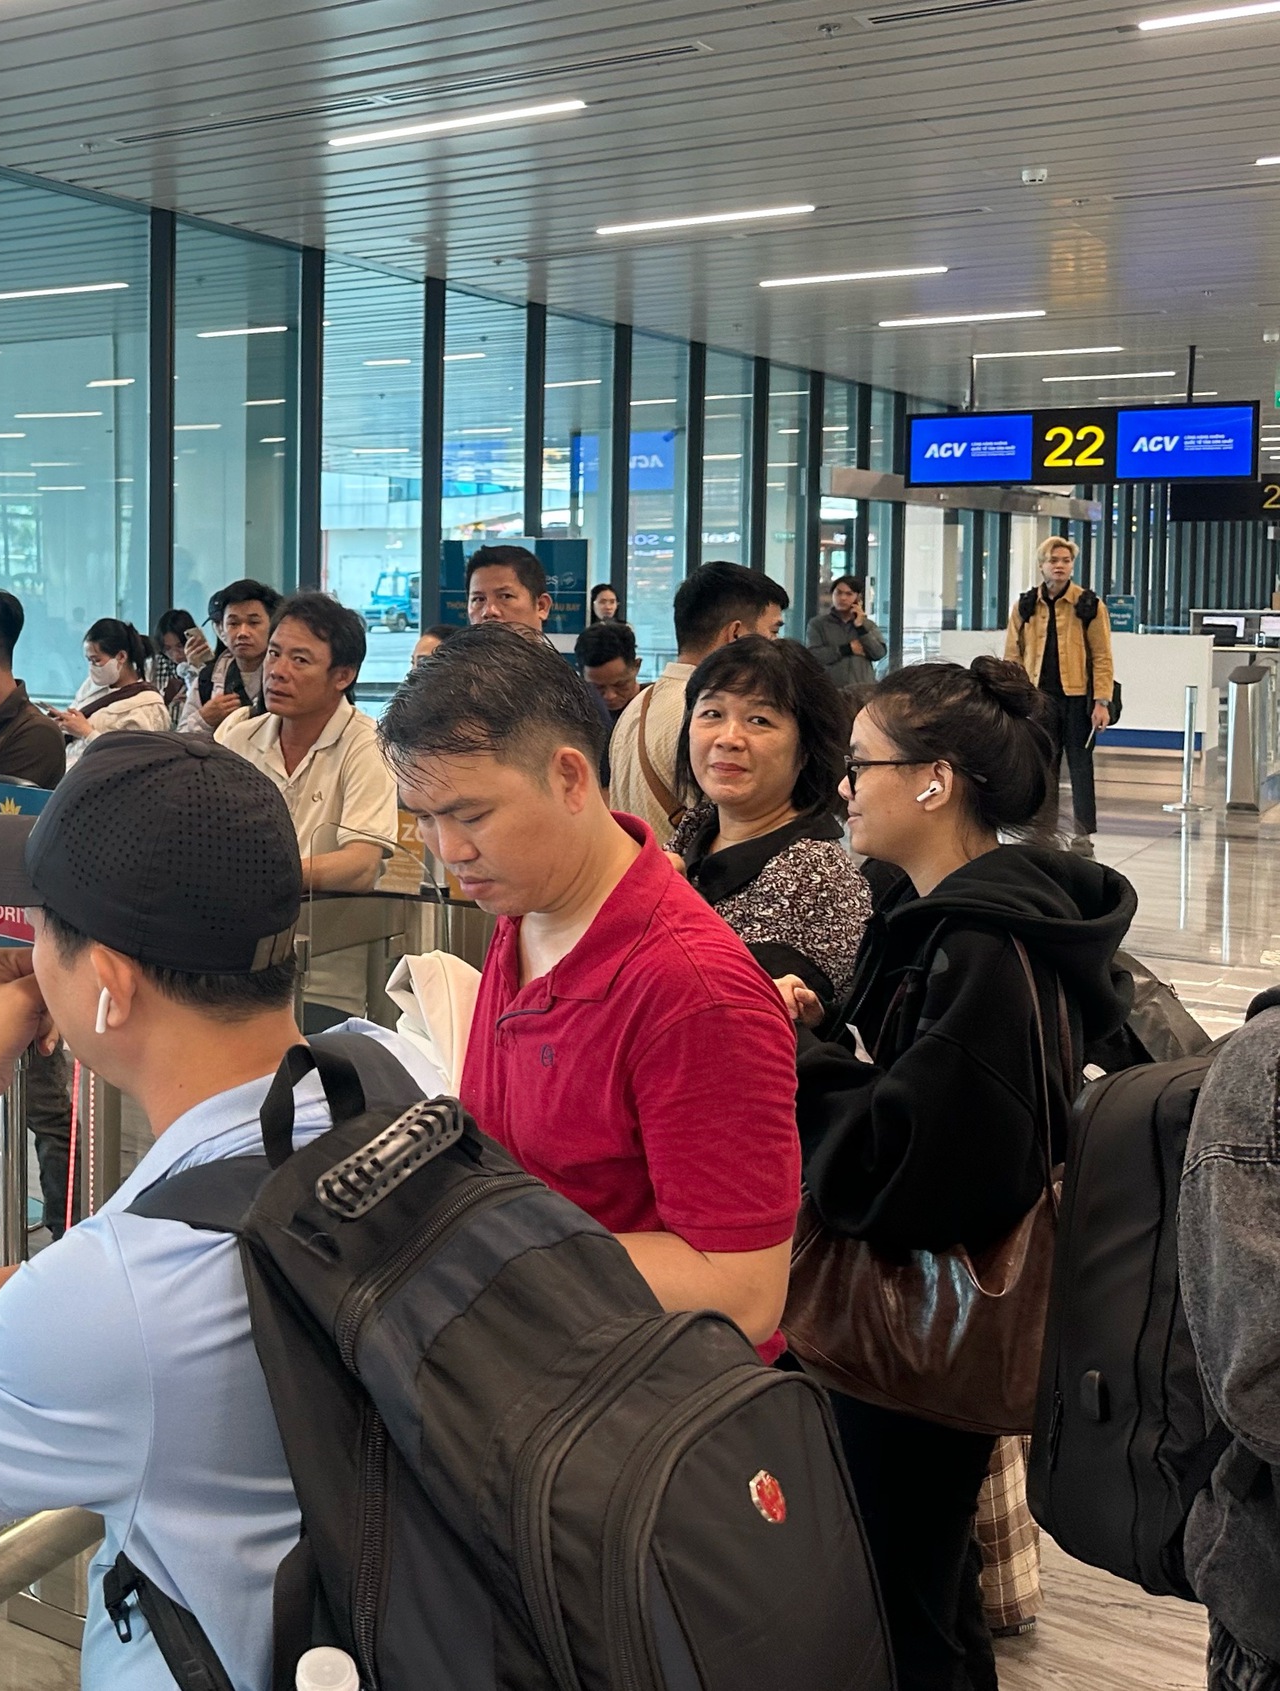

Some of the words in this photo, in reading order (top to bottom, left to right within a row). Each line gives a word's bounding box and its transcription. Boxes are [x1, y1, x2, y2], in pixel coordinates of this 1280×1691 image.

[924, 442, 968, 458] ACV
[1043, 425, 1105, 467] 22
[1131, 435, 1180, 452] ACV
